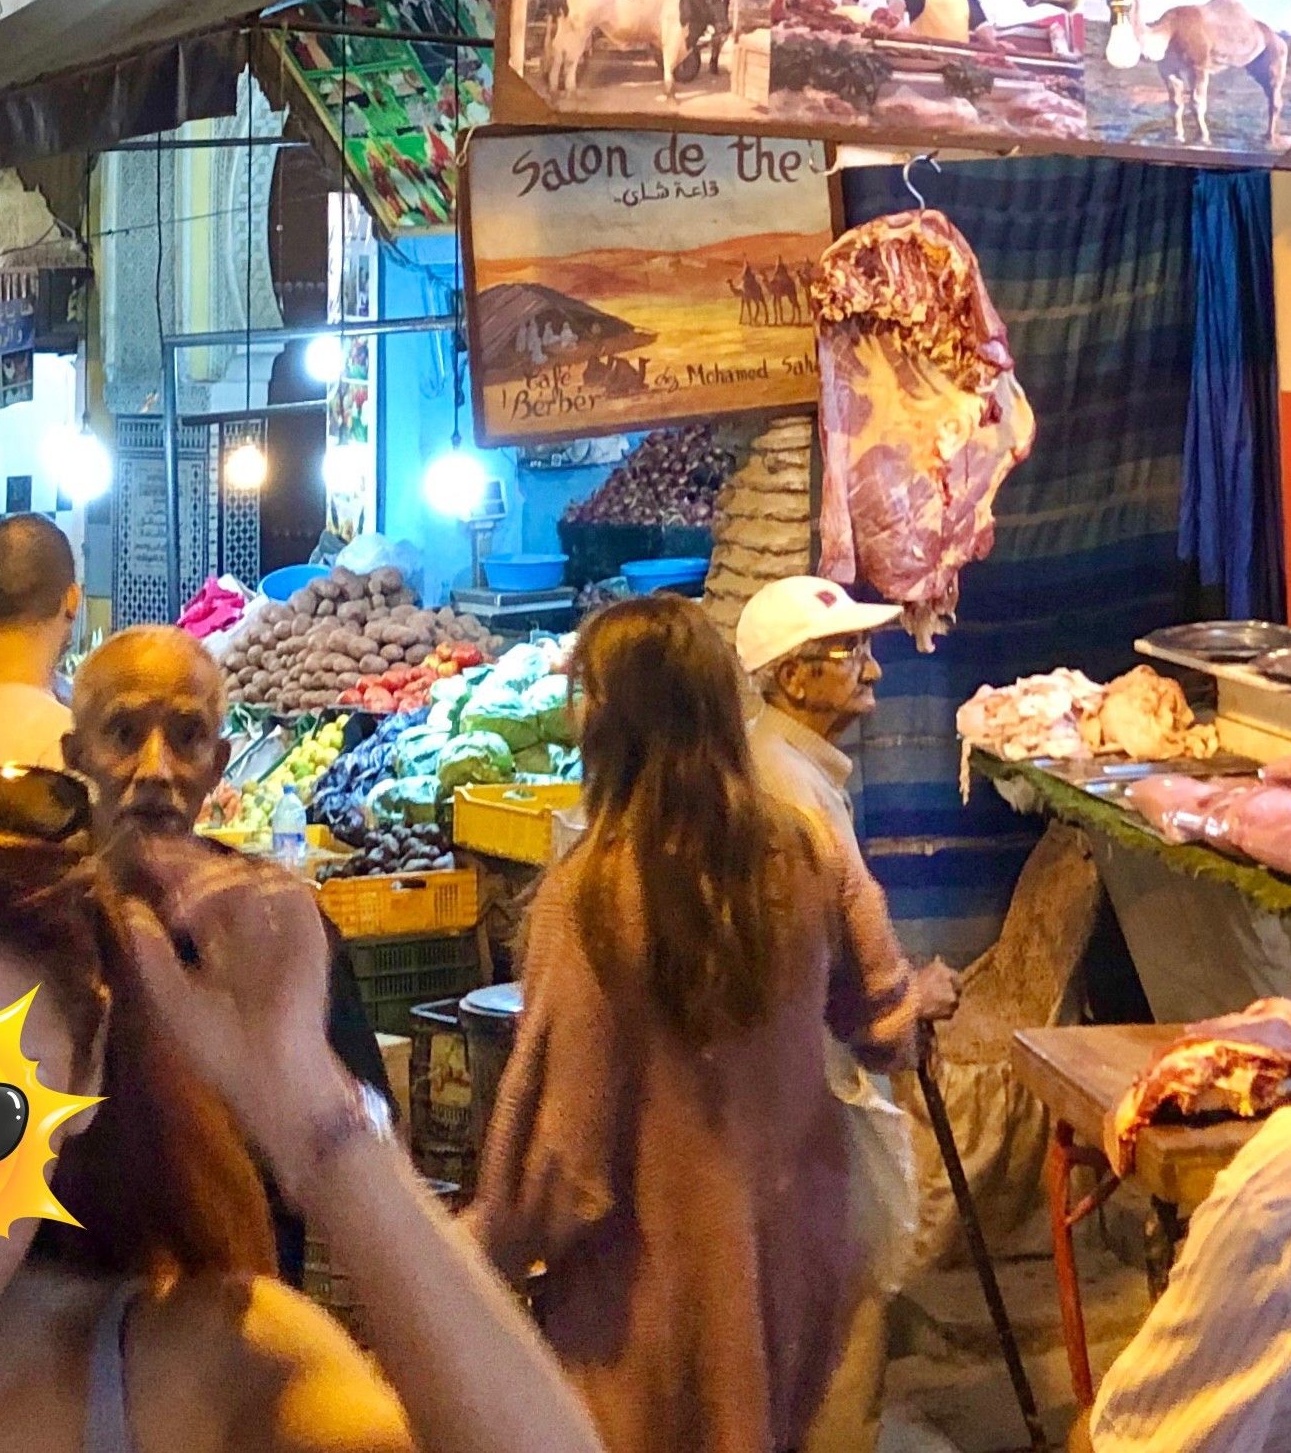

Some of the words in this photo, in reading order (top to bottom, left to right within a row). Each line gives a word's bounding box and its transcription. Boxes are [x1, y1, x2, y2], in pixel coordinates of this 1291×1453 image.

[512, 143, 633, 197] Salon
[654, 132, 707, 178] de
[686, 358, 769, 386] Mohamed
